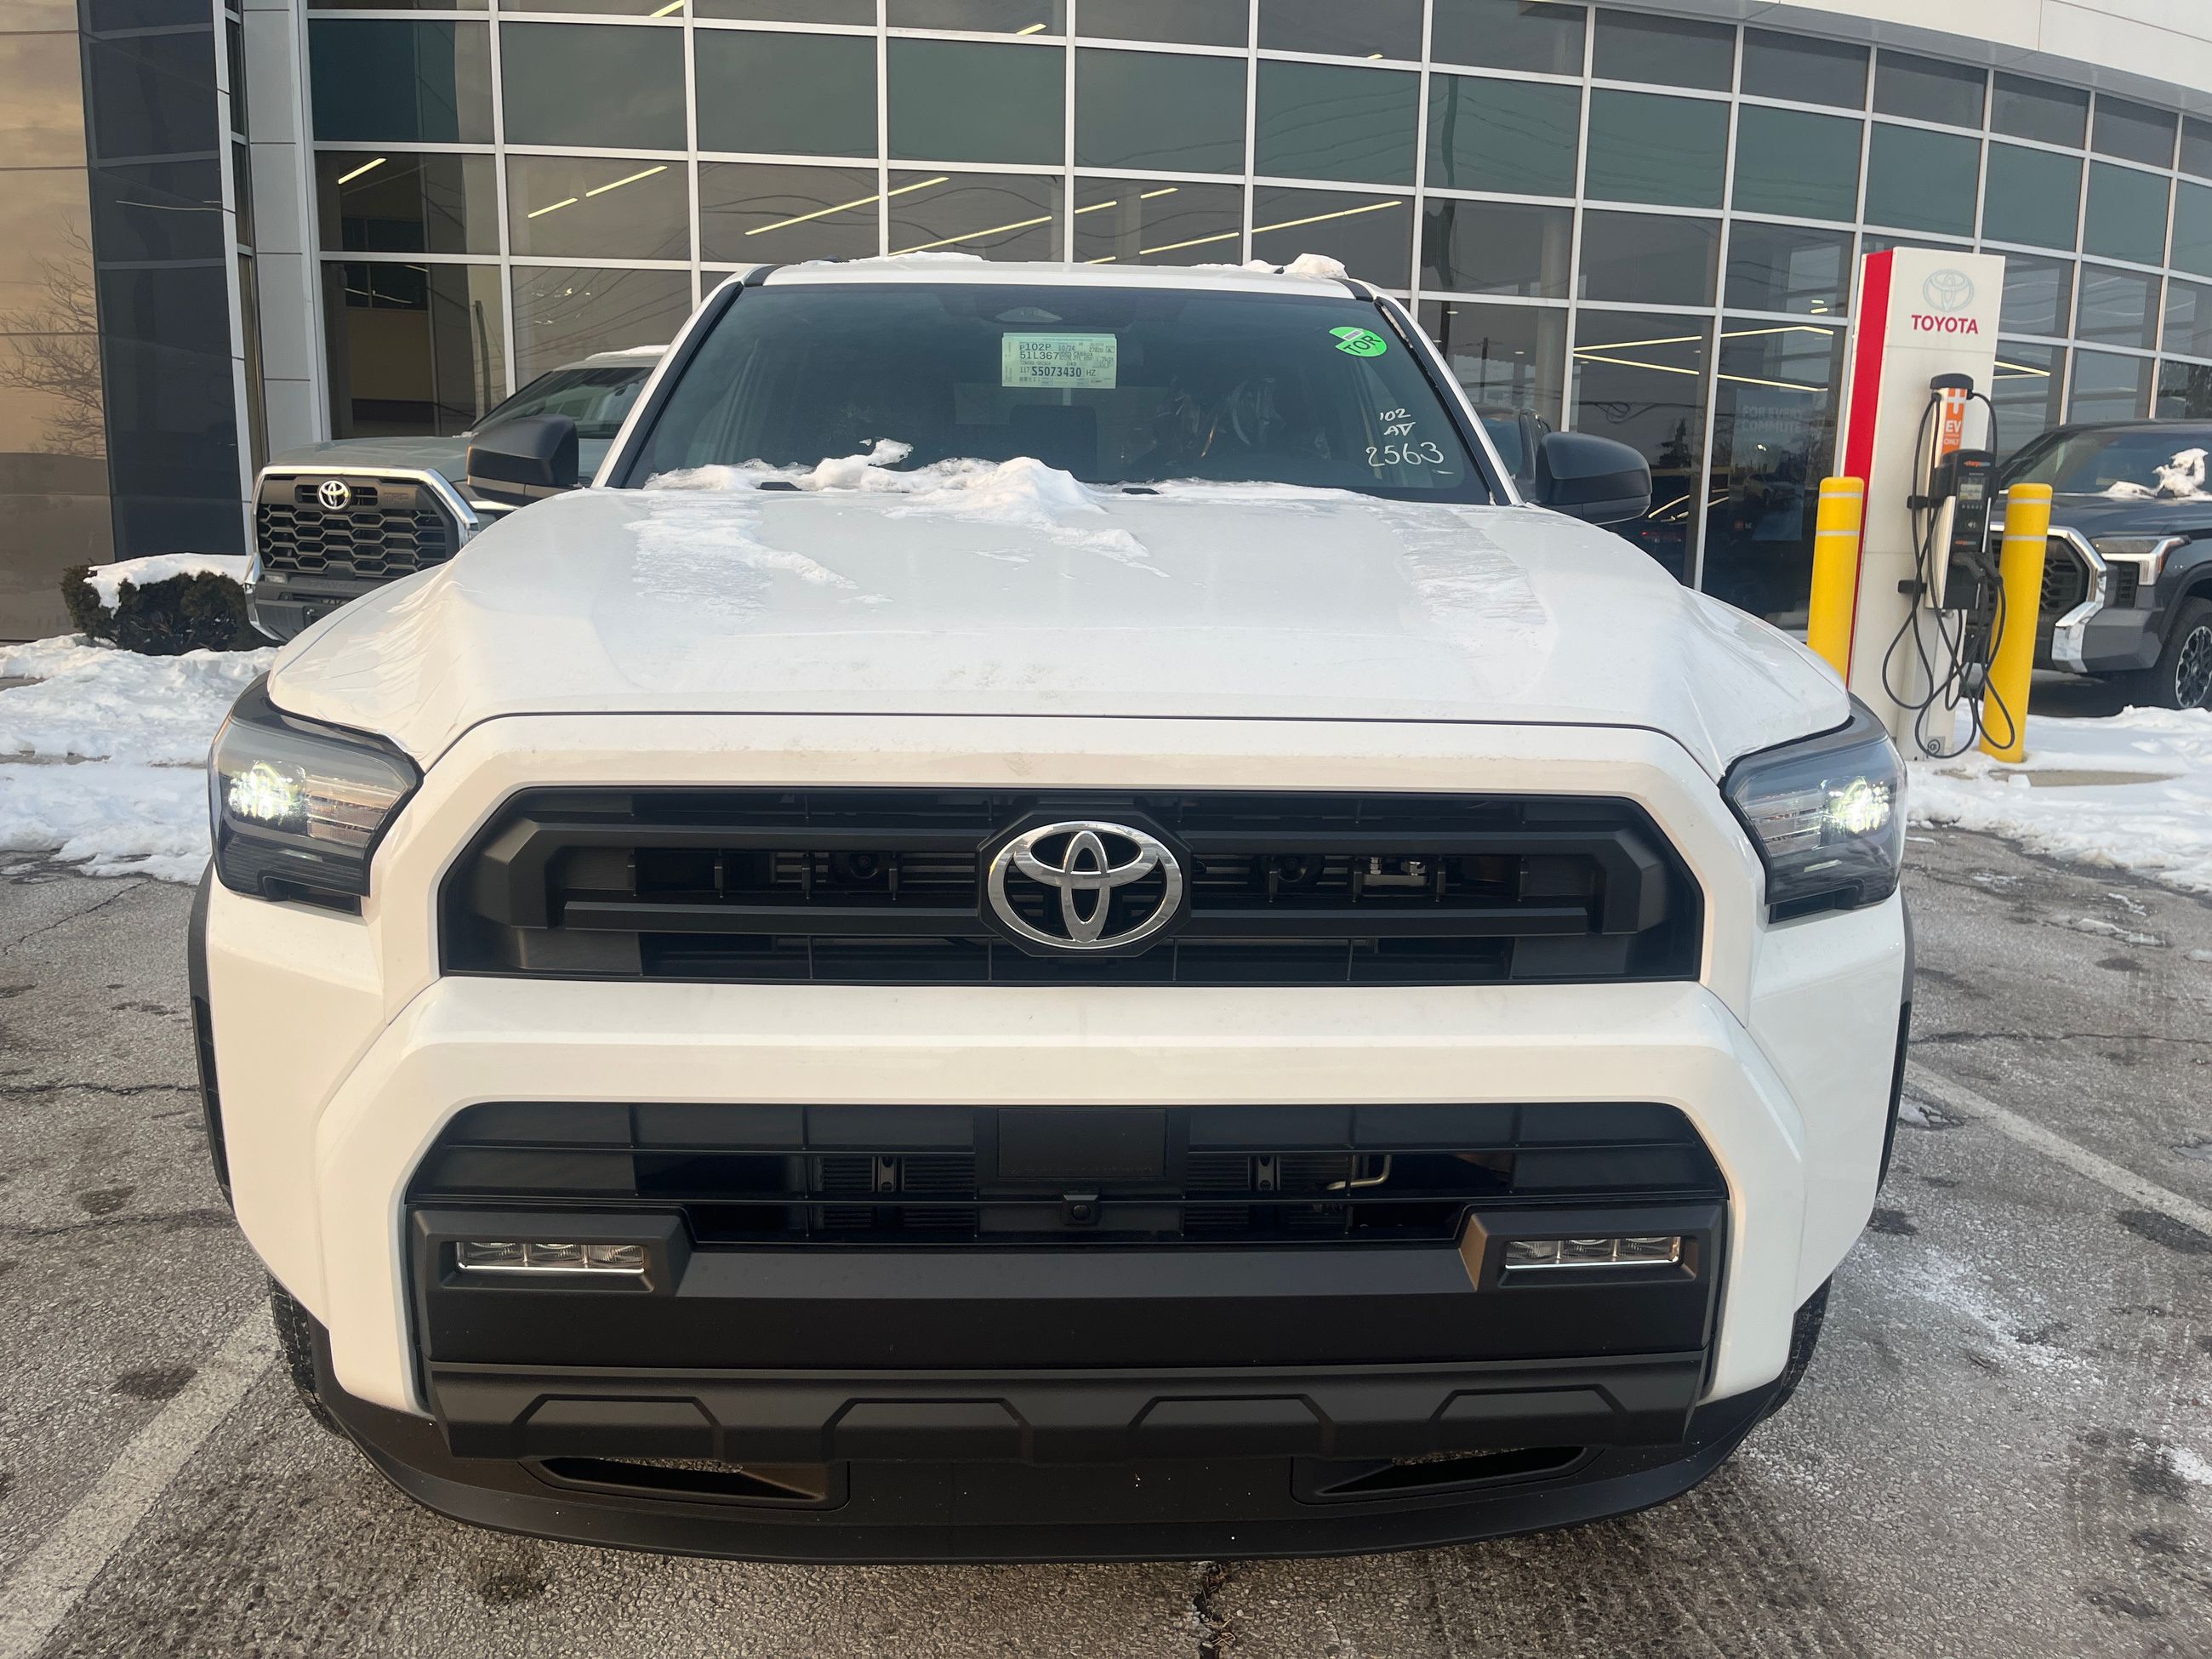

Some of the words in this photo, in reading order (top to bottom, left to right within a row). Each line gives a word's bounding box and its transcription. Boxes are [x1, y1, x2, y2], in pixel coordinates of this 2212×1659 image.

[1912, 315, 1978, 334] TOYOTA
[1343, 335, 1382, 354] TOR
[1031, 366, 1082, 377] S5073430
[1945, 419, 1962, 433] EV
[1943, 437, 1960, 446] ONLY
[1365, 441, 1445, 467] 2563
